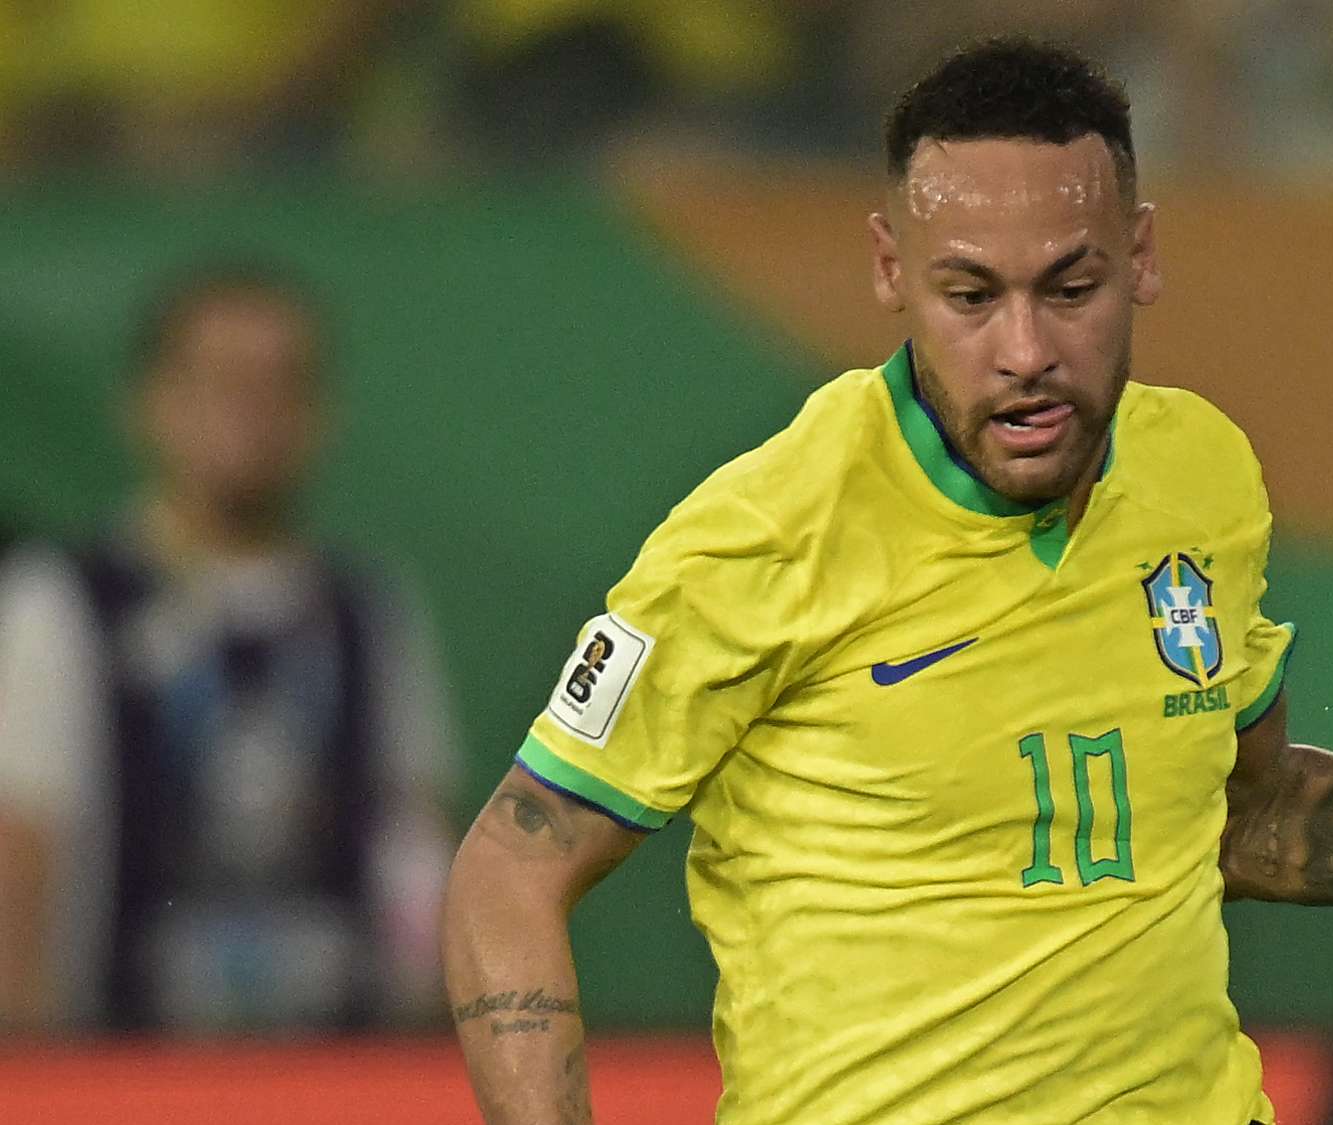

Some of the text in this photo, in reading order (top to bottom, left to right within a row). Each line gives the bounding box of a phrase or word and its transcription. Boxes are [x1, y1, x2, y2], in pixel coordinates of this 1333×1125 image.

[1170, 608, 1199, 625] CBF
[1163, 684, 1231, 718] BRASIL
[1017, 727, 1136, 889] 10
